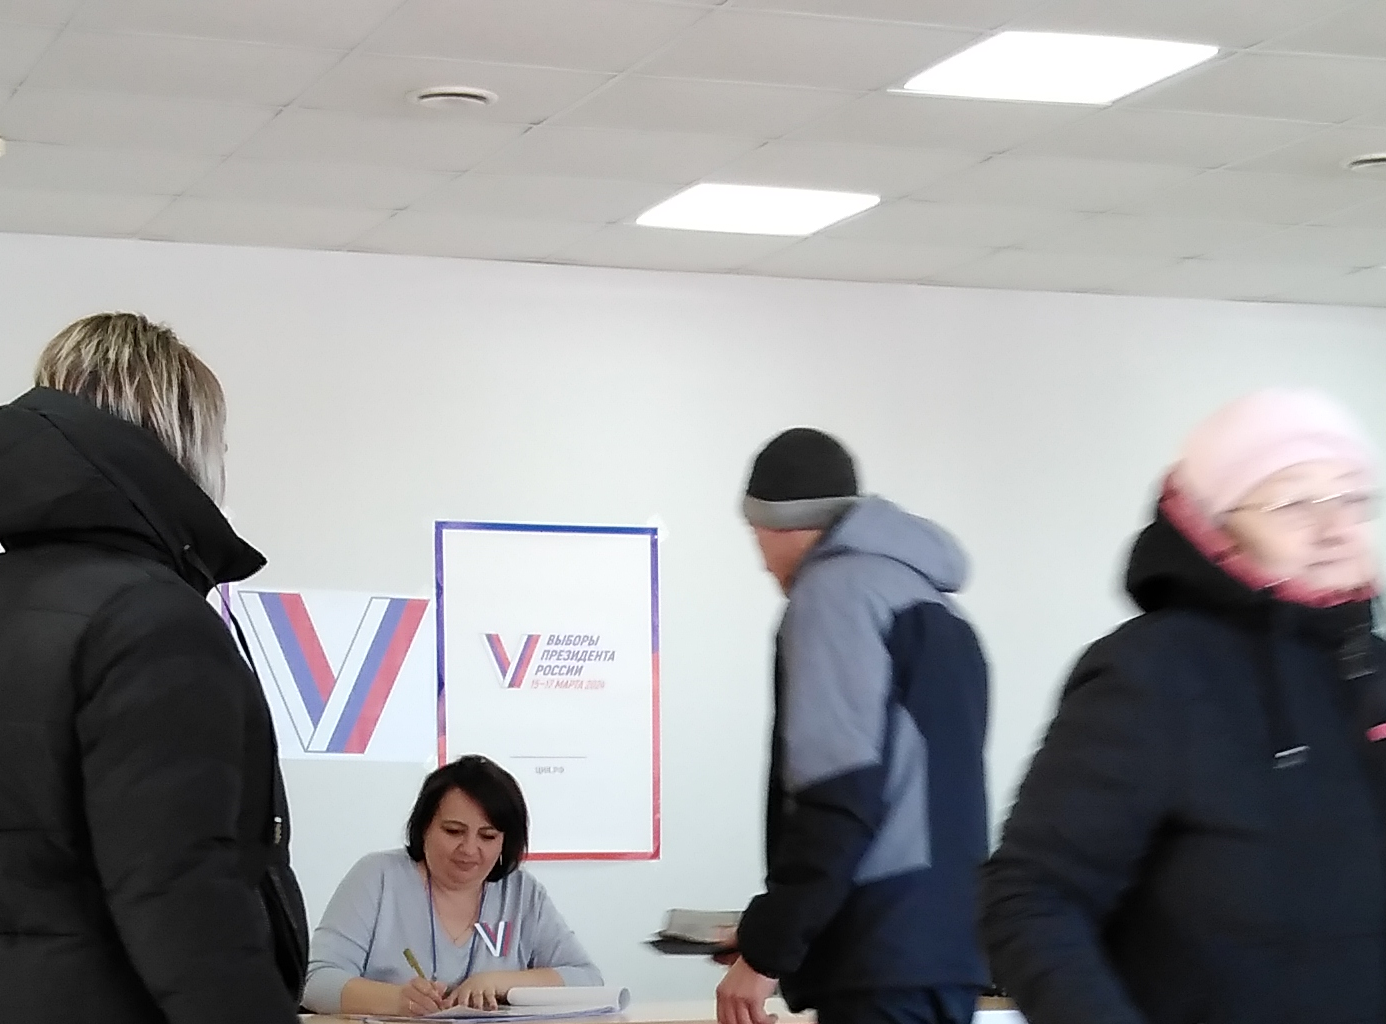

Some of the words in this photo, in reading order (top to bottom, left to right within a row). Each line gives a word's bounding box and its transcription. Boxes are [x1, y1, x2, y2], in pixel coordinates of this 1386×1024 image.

[547, 634, 600, 646] ВЫБОРЫ
[540, 650, 616, 662] ПРЕЗИДЕНТА
[534, 665, 584, 676] РОССИИ
[554, 680, 584, 690] МАРТА
